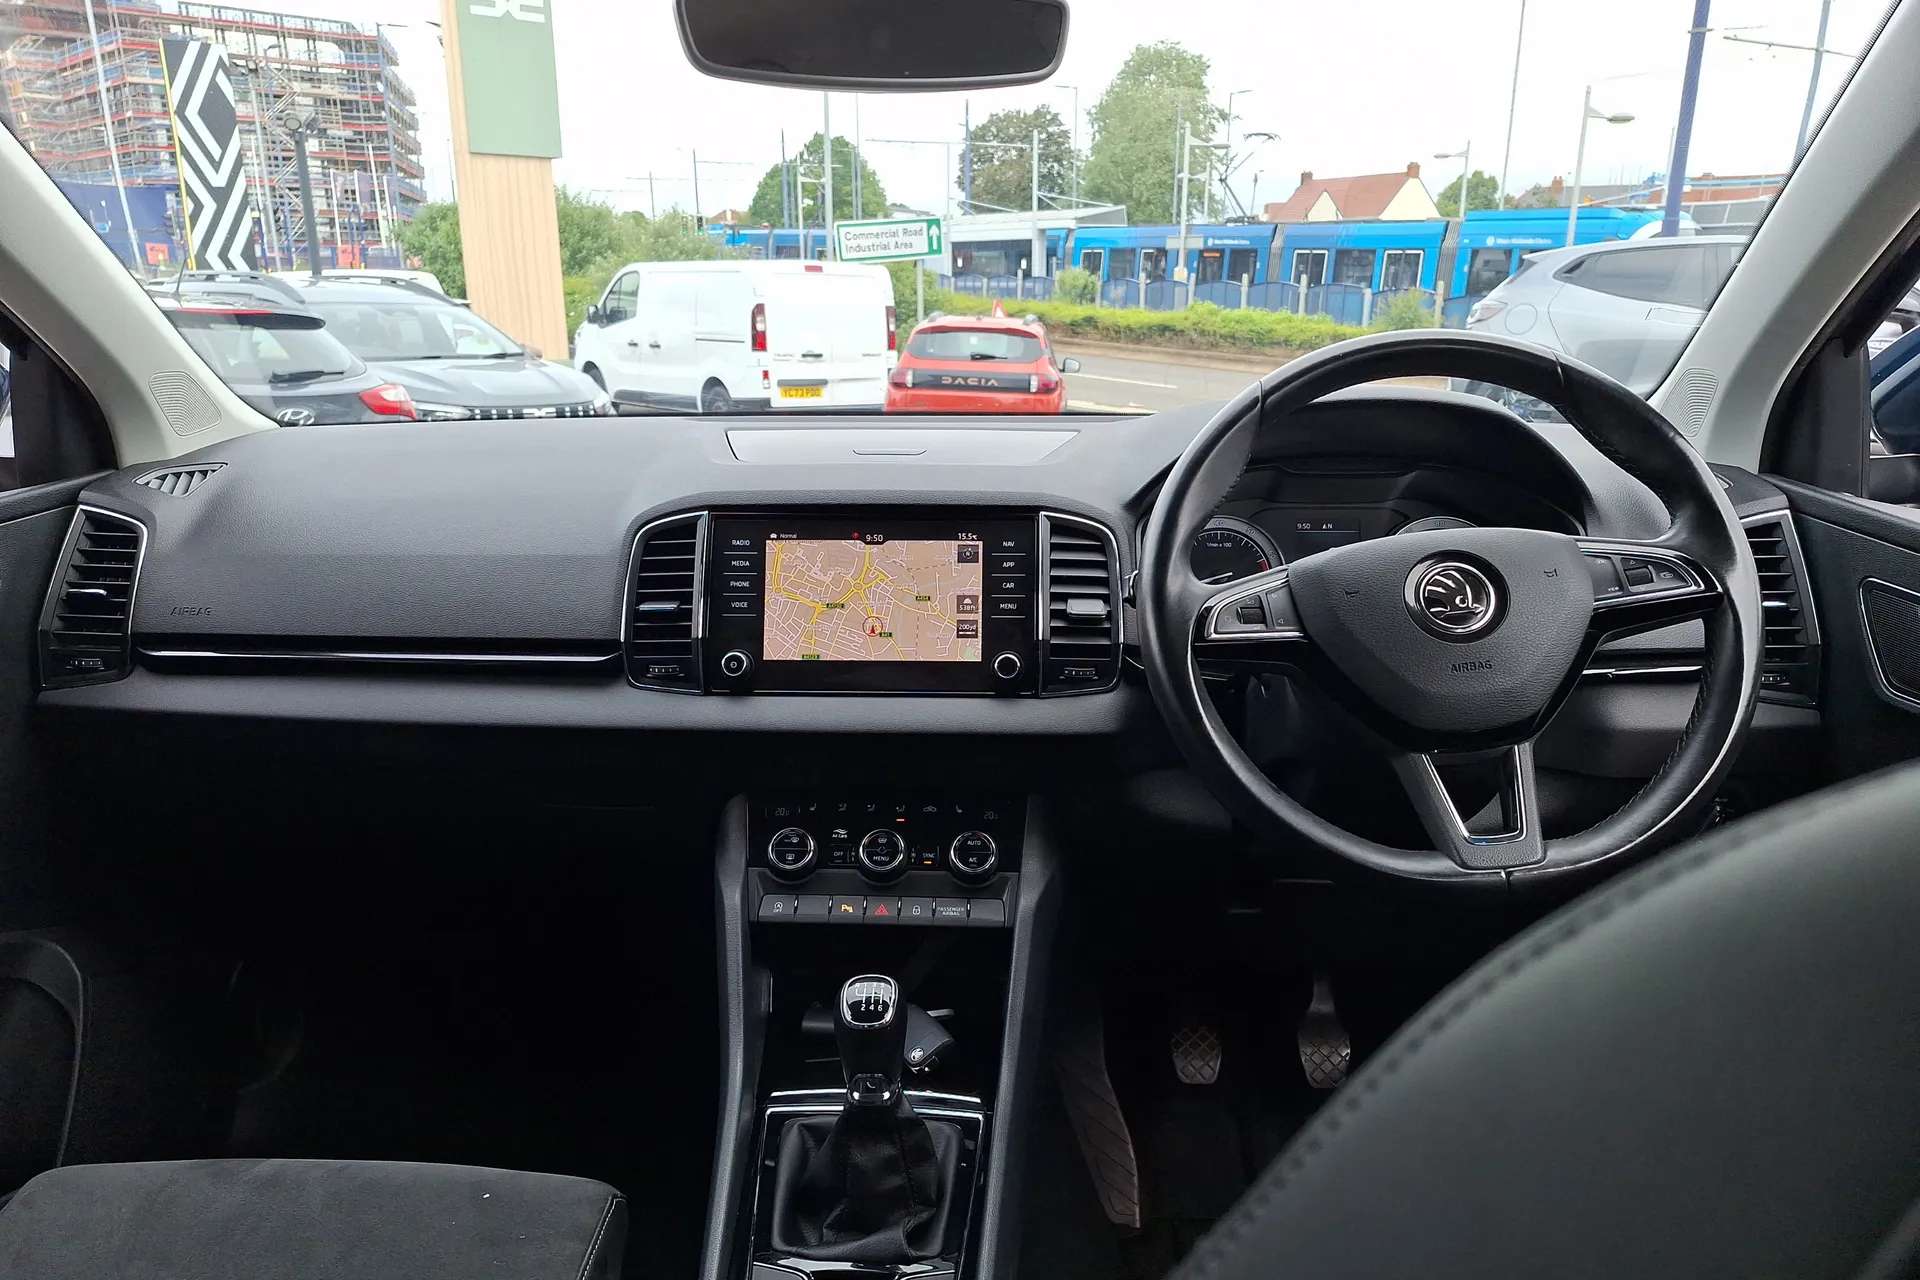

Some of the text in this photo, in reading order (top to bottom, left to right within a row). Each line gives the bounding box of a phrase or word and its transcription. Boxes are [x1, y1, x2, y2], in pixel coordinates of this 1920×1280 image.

[844, 226, 924, 241] Commercial Road
[846, 241, 913, 254] Industrial Area
[941, 375, 999, 386] DACIA
[865, 534, 884, 542] 9:50
[170, 606, 213, 616] AIRBAG
[1450, 660, 1493, 673] AIRBAG
[860, 1003, 883, 1012] 2 4 6
